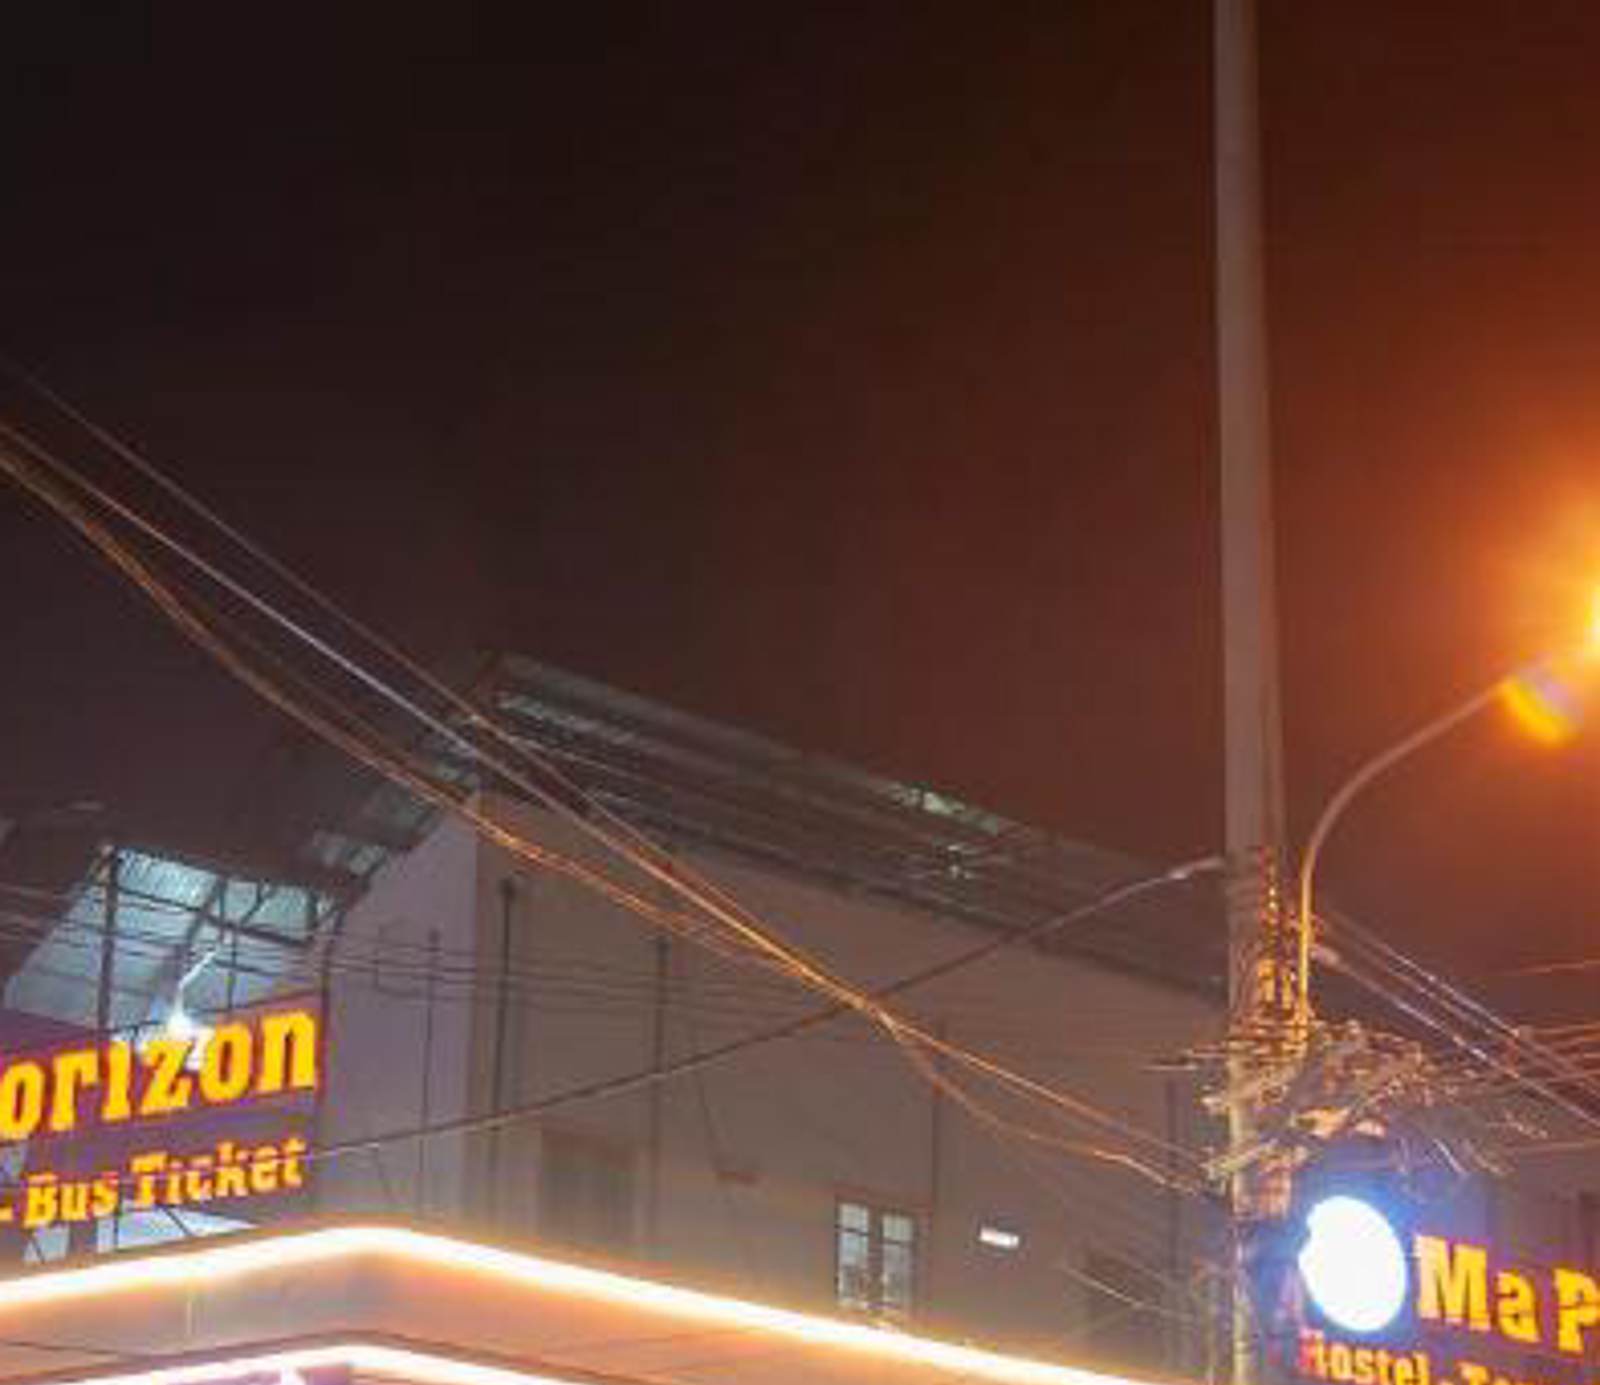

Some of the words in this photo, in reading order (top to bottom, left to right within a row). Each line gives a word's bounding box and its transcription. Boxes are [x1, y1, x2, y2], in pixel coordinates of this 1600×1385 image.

[23, 1171, 119, 1229] Bus
[130, 1137, 306, 1207] Ticket
[1414, 1233, 1541, 1343] Ma
